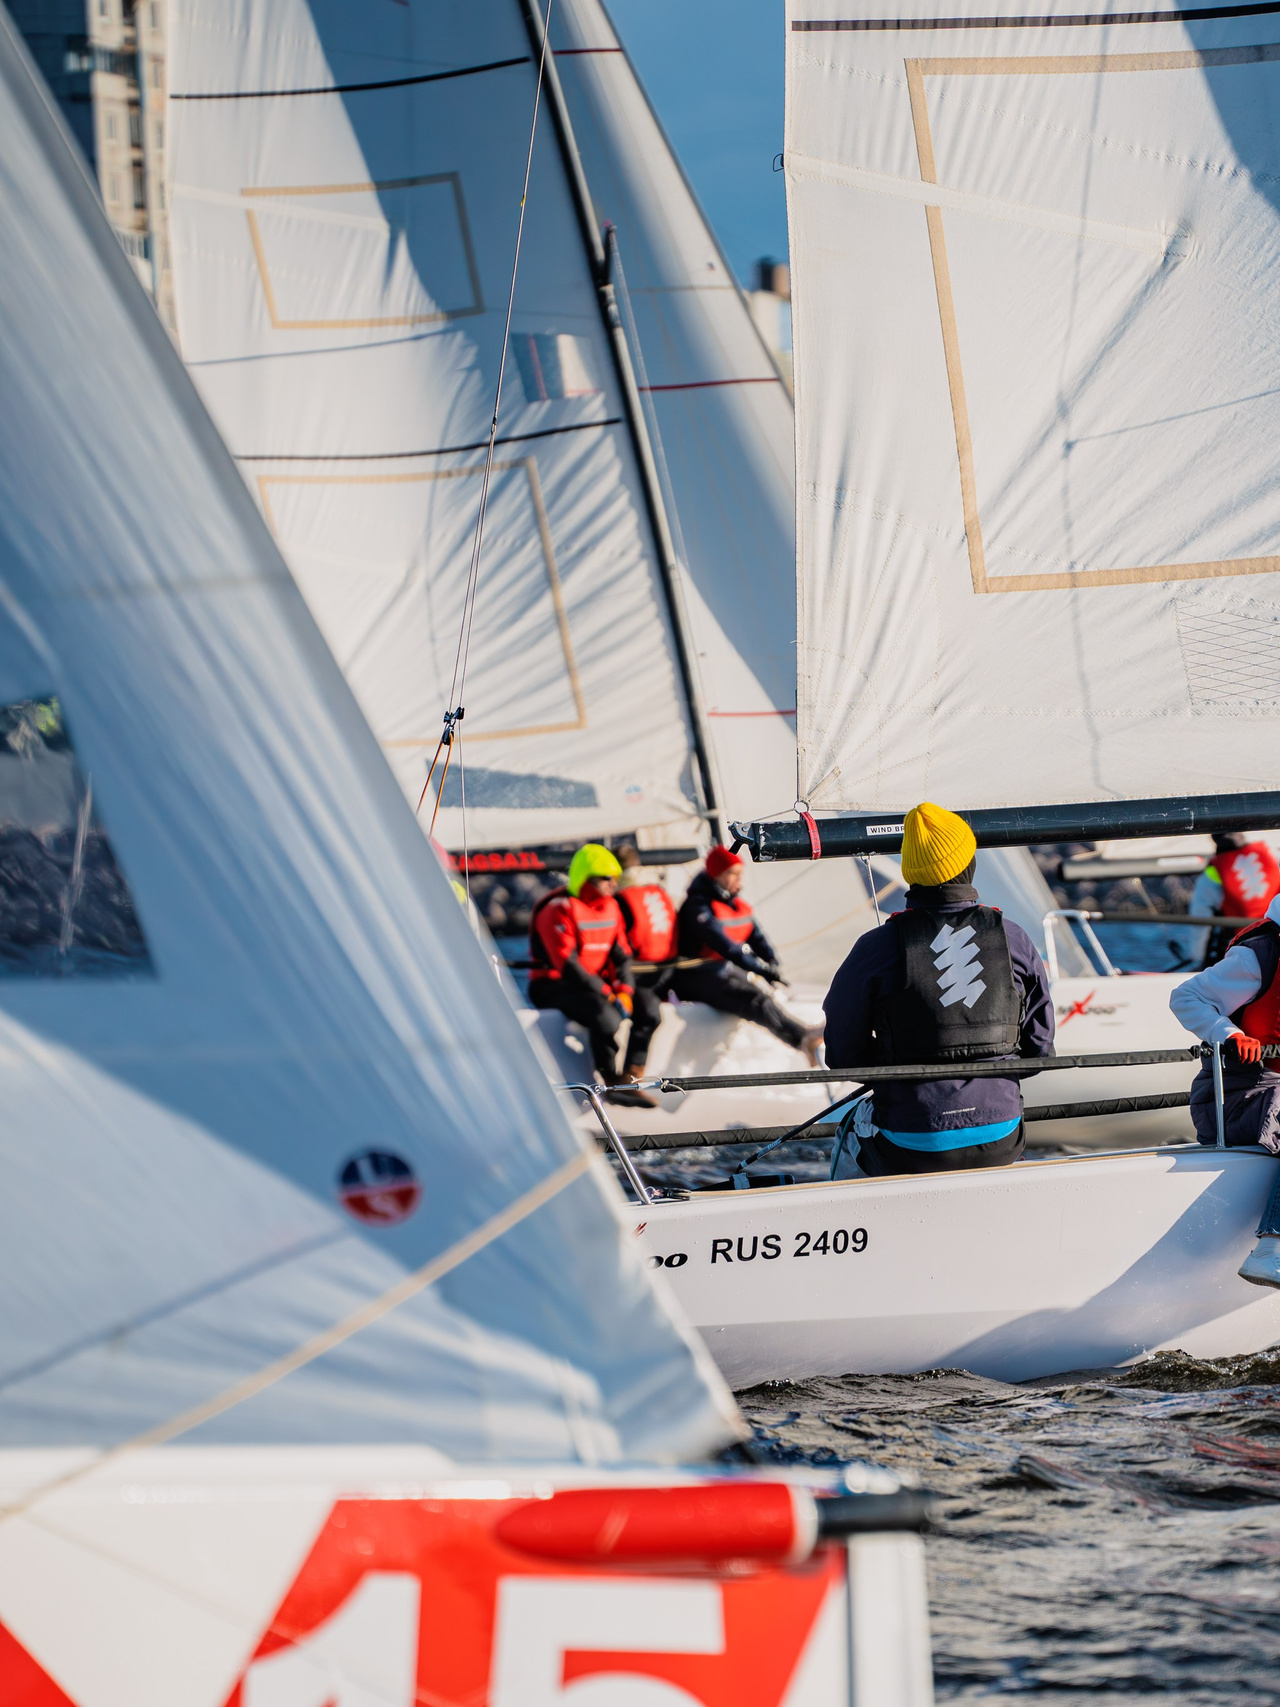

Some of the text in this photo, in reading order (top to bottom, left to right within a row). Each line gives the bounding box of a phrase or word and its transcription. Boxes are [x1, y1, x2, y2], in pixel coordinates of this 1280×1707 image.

[870, 826, 892, 834] WIND
[710, 1228, 869, 1264] RUS 2409
